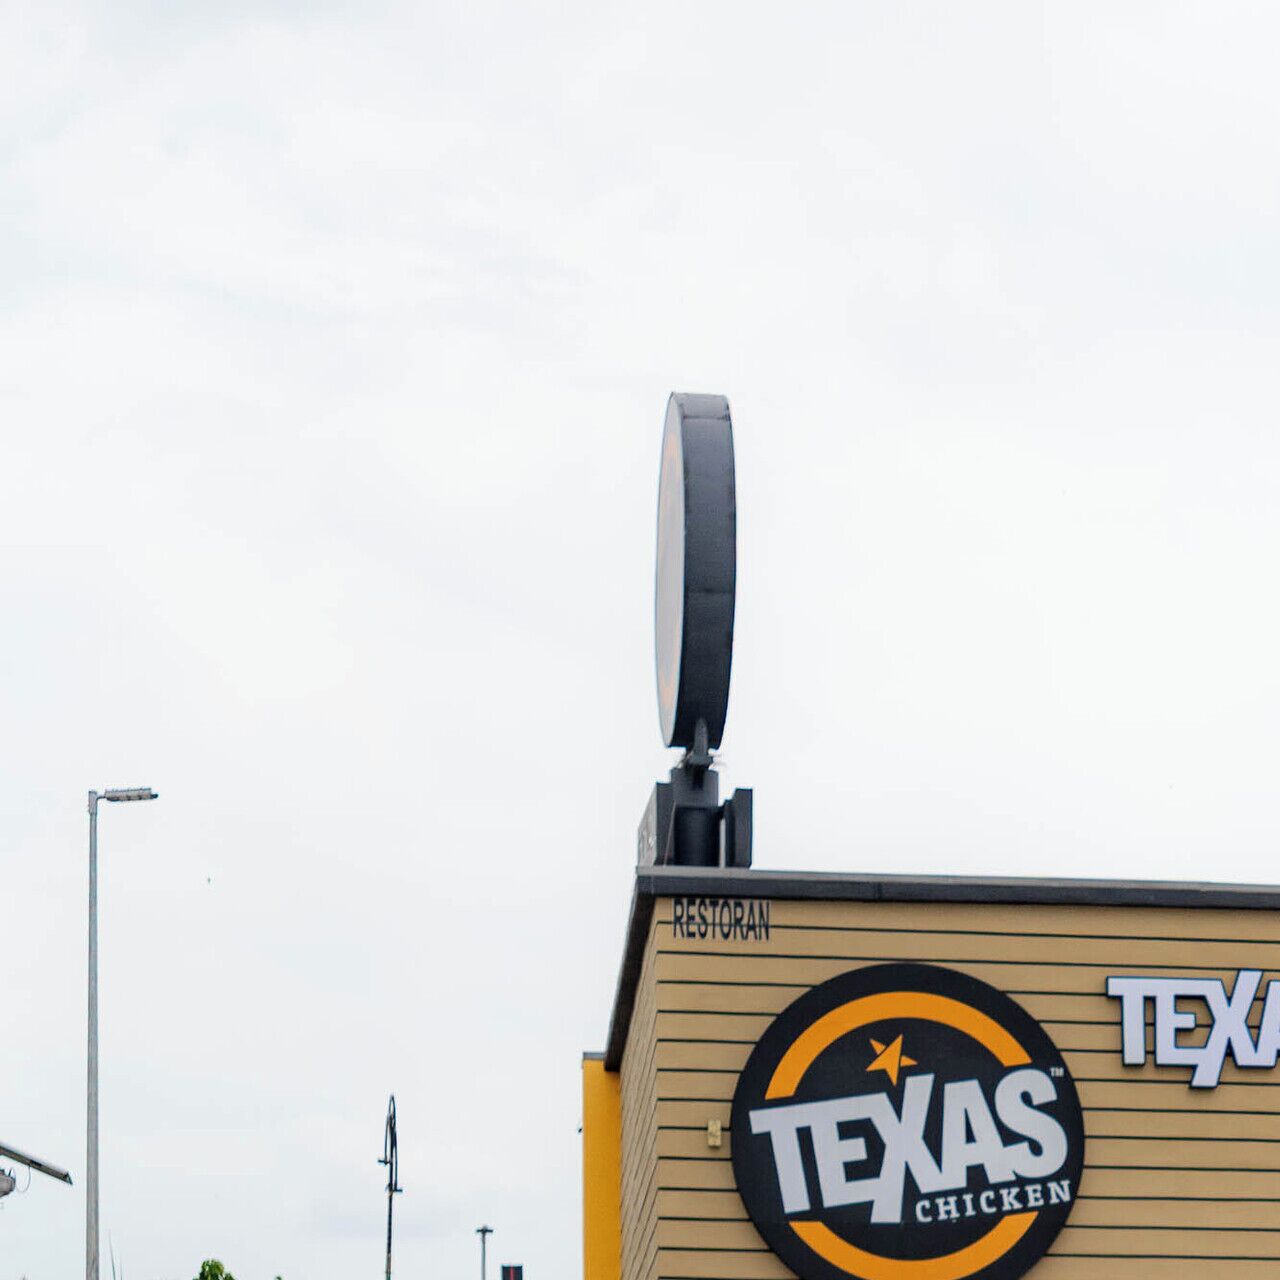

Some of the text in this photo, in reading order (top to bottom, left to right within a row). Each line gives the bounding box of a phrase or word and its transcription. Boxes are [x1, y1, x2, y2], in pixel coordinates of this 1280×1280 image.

[673, 899, 770, 941] RESTORAN
[749, 1067, 1068, 1224] TEXAS
[914, 1180, 1072, 1224] CHICKEN
